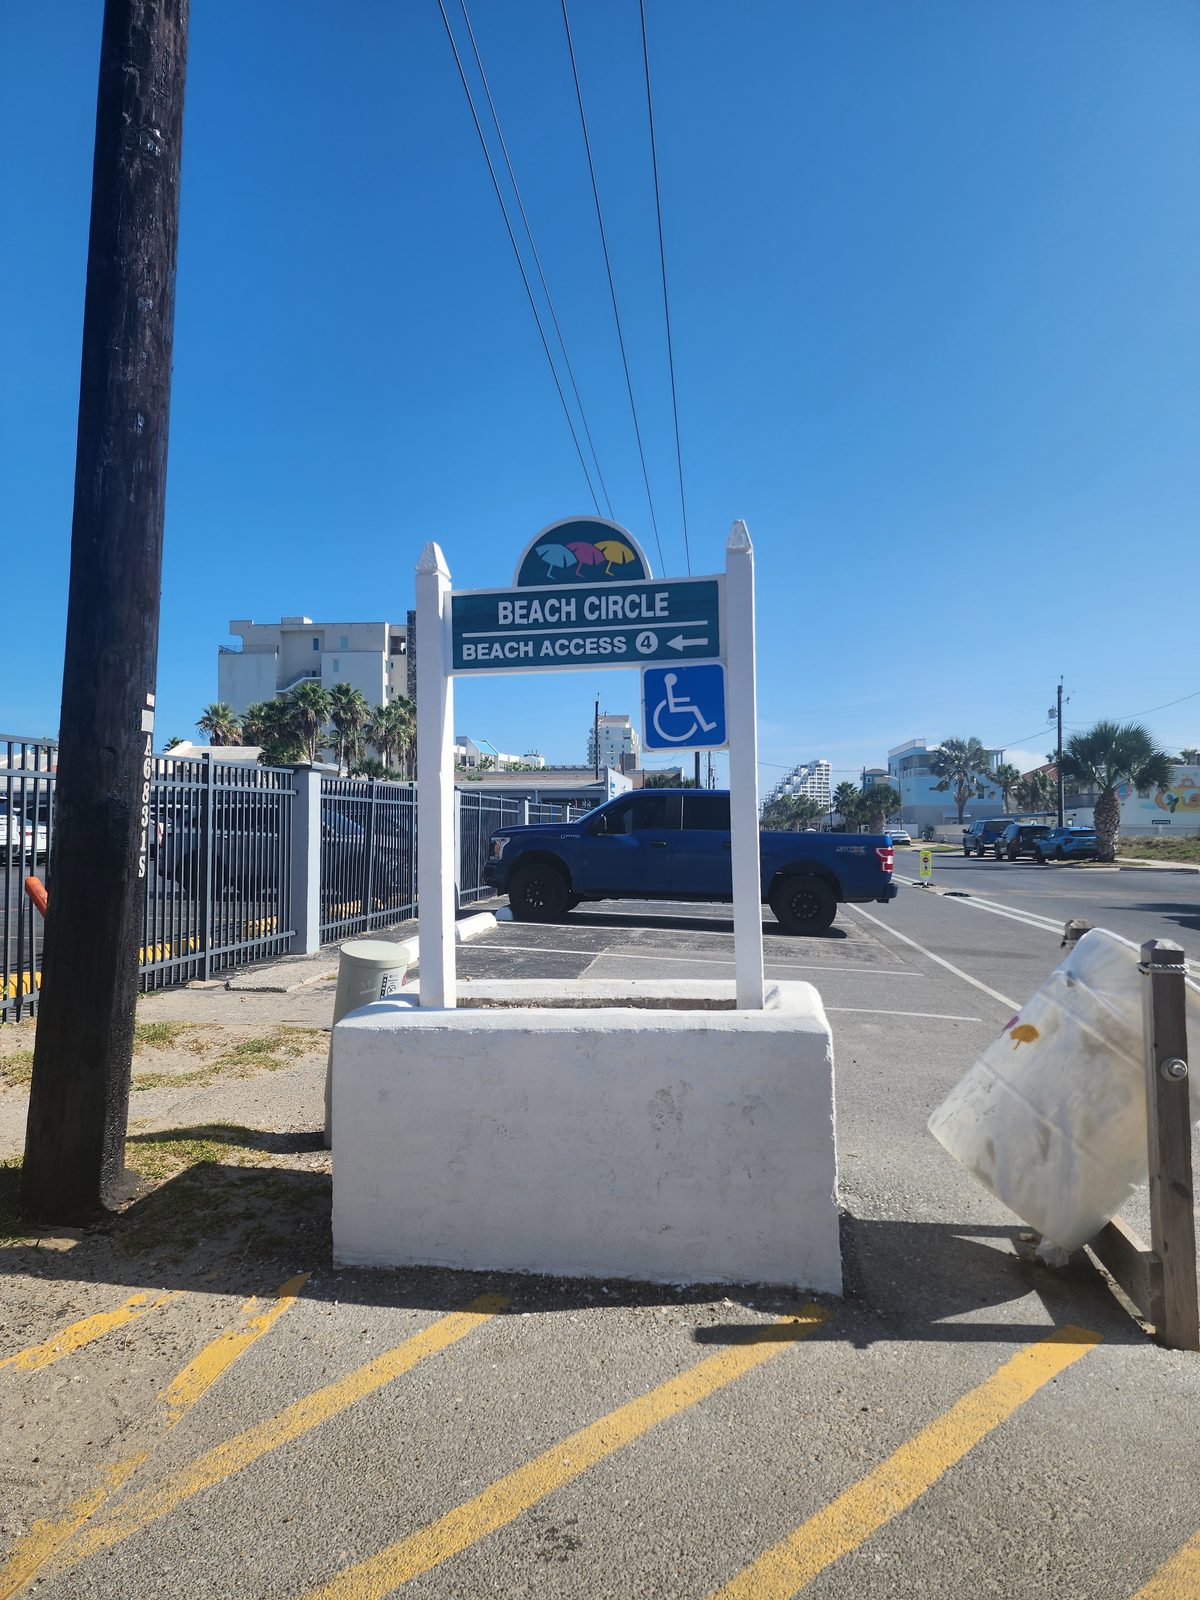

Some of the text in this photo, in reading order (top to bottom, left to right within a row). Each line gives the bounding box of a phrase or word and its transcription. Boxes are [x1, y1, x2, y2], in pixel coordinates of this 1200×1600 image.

[498, 592, 669, 625] BEACH CIRCLE
[462, 635, 653, 661] BEACH ACCESS 4
